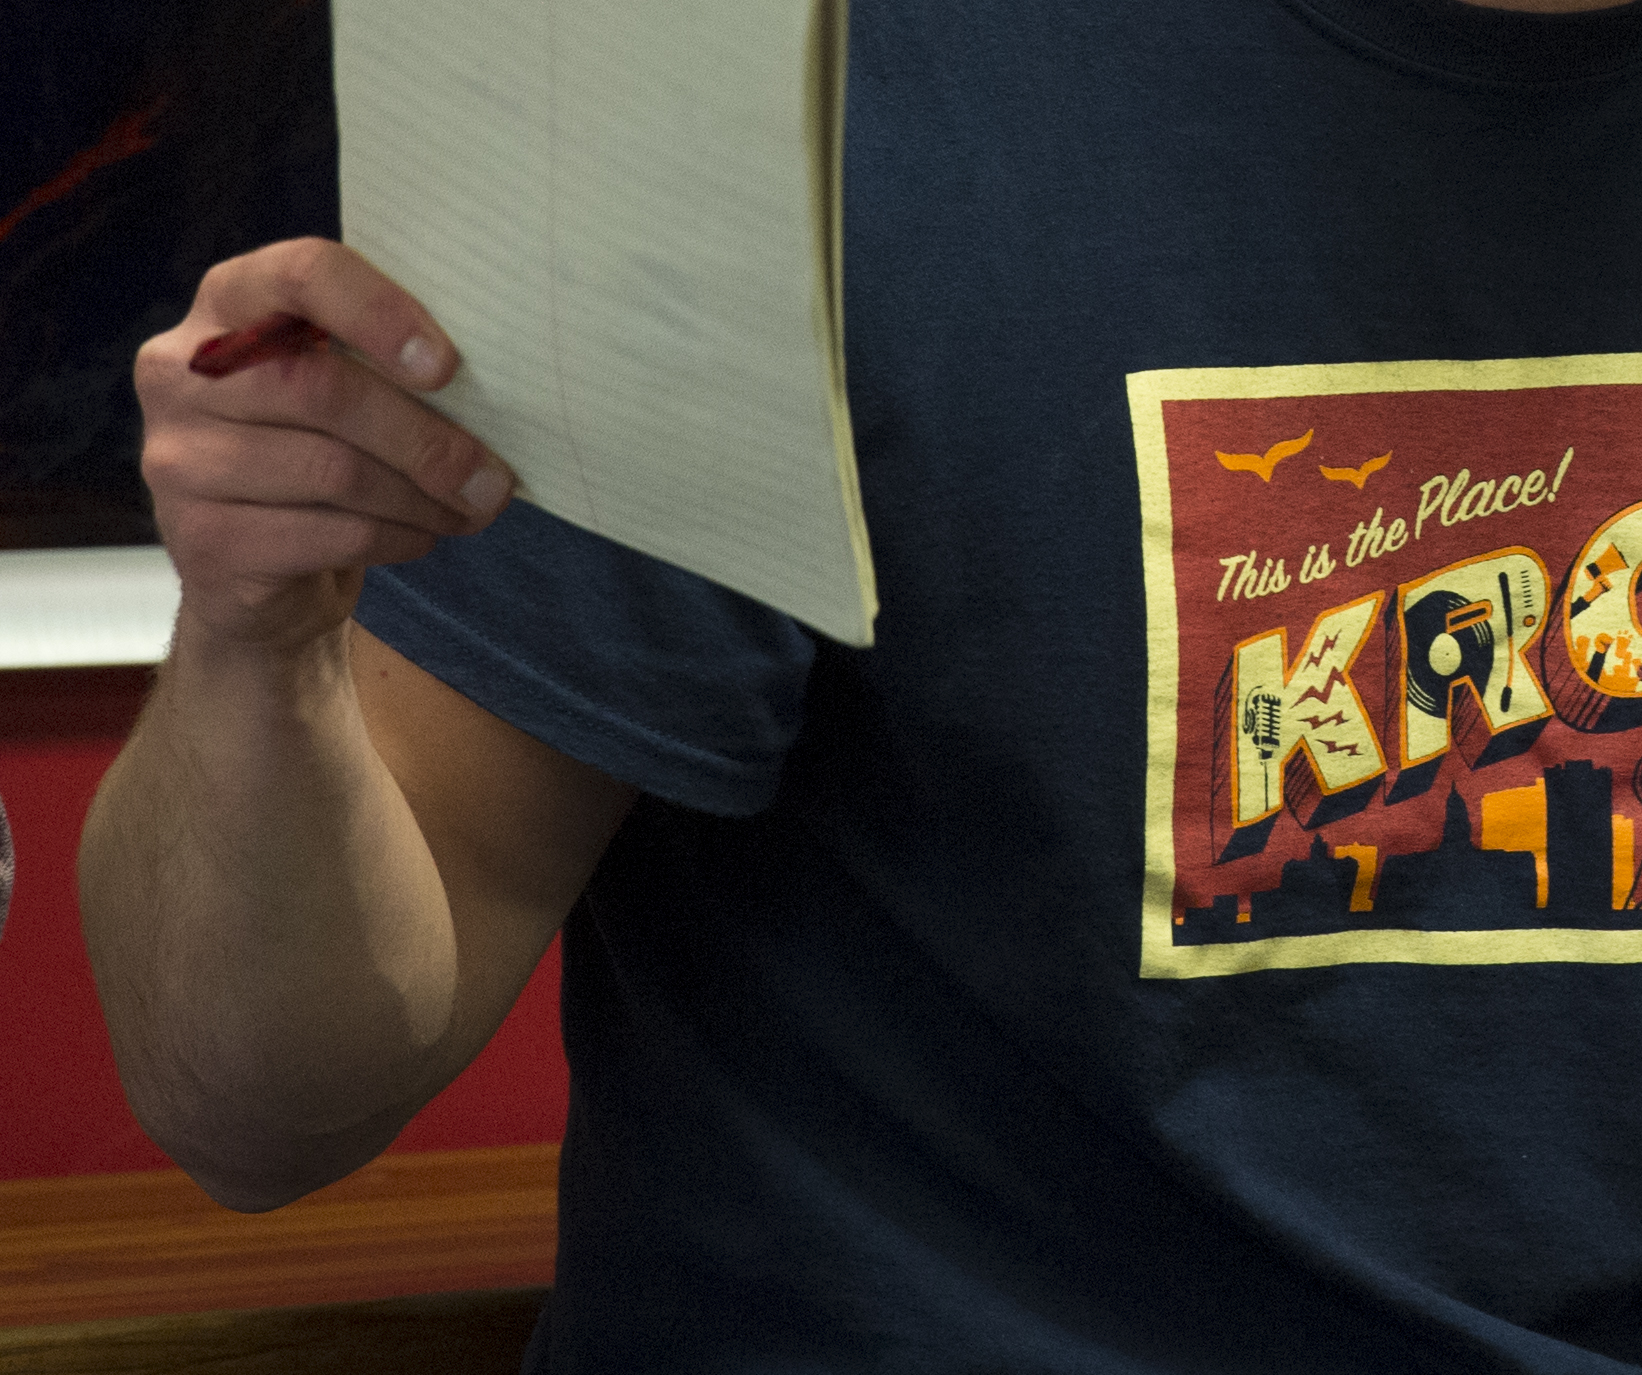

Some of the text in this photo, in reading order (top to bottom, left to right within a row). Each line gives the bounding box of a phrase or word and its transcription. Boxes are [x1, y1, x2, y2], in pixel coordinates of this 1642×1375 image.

[1216, 446, 1577, 603] This is the Place!
